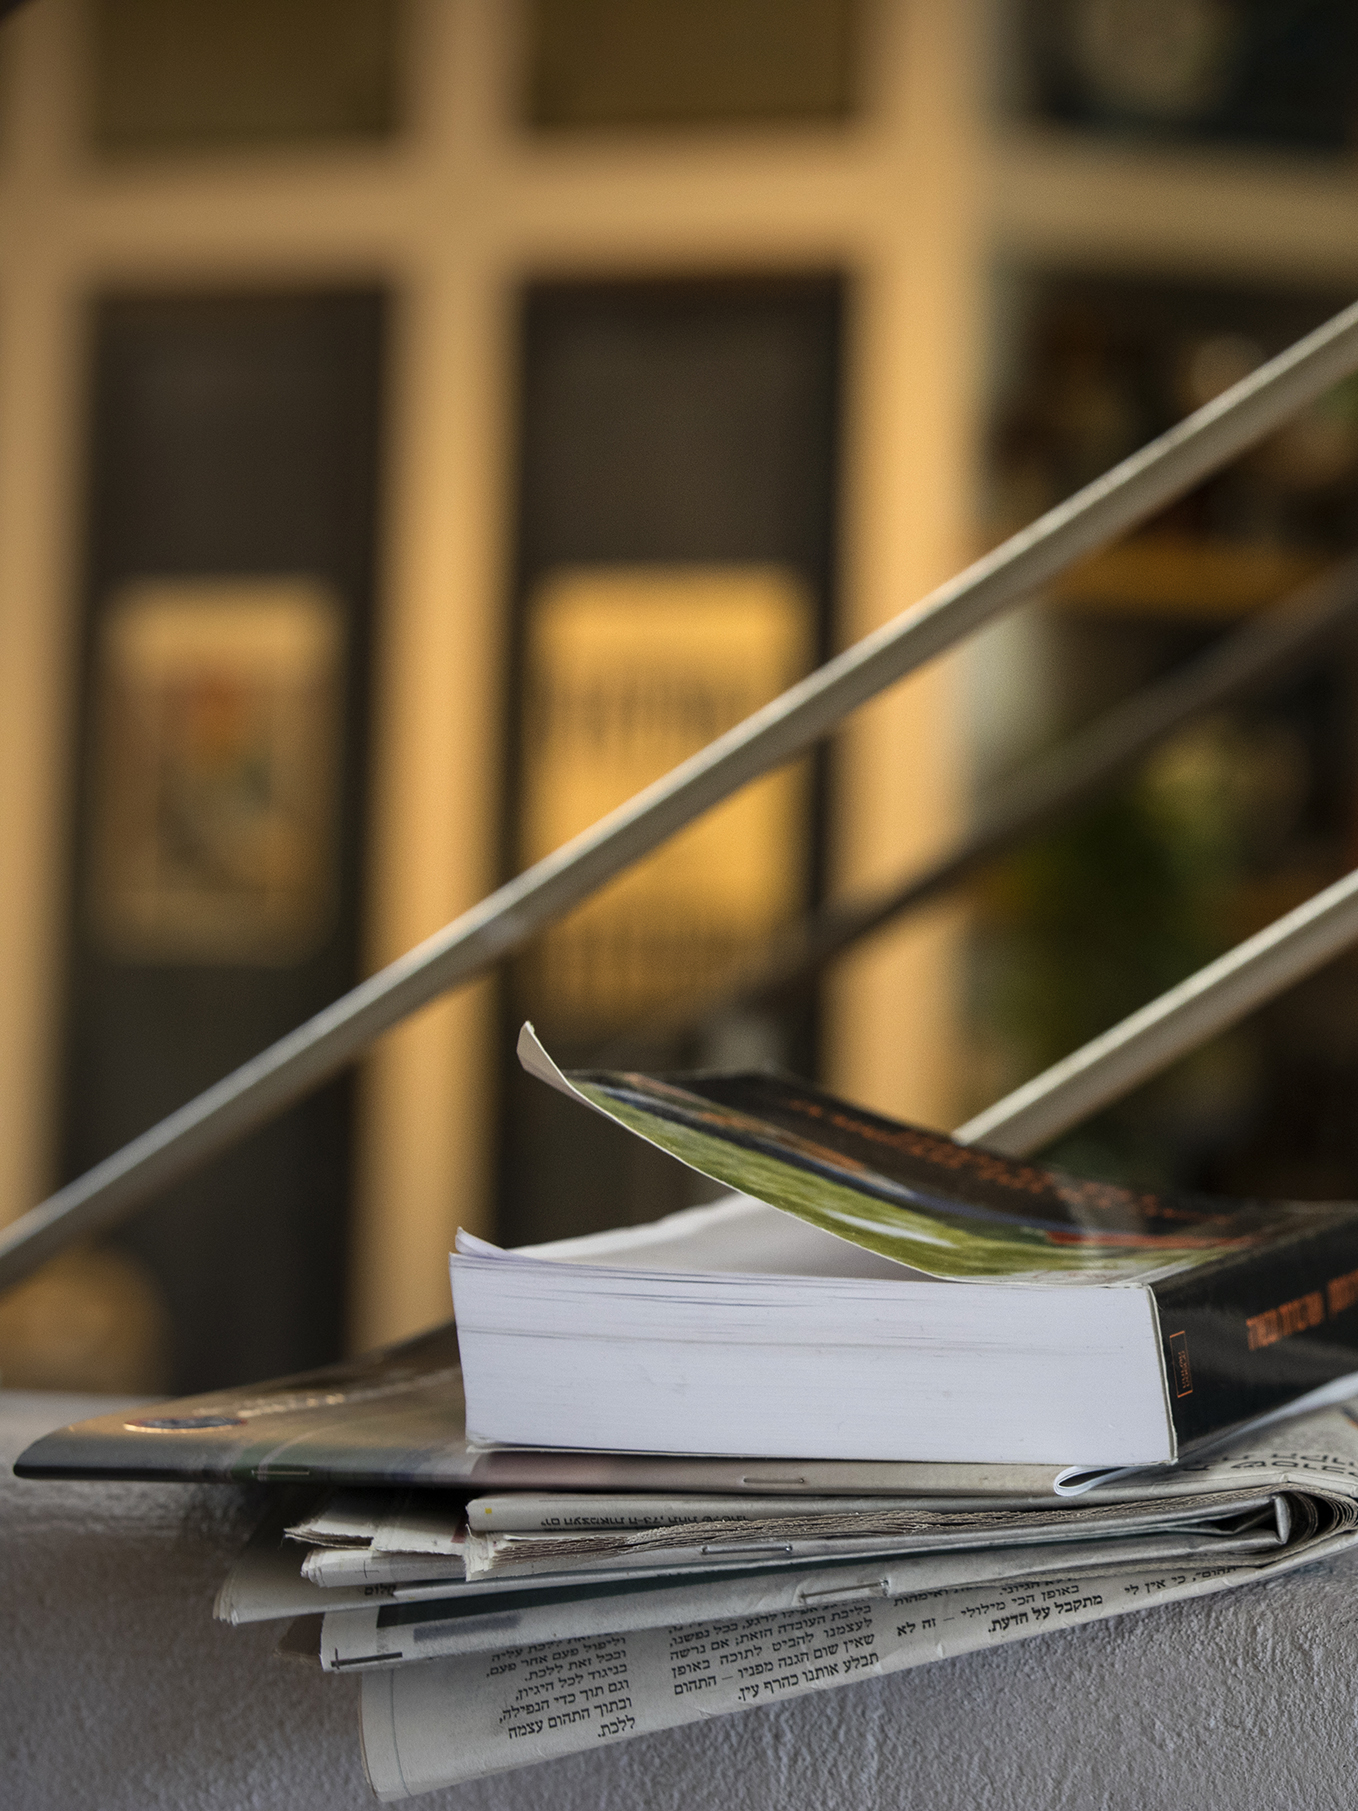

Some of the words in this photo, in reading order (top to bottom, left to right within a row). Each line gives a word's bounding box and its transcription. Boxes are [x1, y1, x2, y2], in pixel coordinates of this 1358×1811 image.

[541, 1517, 560, 1526] יום
[564, 1516, 625, 1526] העצמאות
[1144, 1579, 1166, 1594] אין
[1171, 1575, 1186, 1585] כי
[1041, 1584, 1080, 1602] באופן
[1124, 1584, 1140, 1596] לי
[1011, 1594, 1036, 1606] הכי
[1054, 1594, 1104, 1614] מתקבל
[960, 1601, 1006, 1618] מילולי
[1031, 1606, 1051, 1620] על
[778, 1615, 826, 1635] העובדה
[823, 1617, 873, 1639] לעצמנו
[897, 1621, 916, 1637] לא
[922, 1617, 937, 1630] זה
[988, 1611, 1029, 1633] הדעת.
[711, 1638, 730, 1651] אם
[772, 1632, 815, 1652] להביט
[844, 1633, 876, 1652] שאין
[521, 1655, 548, 1667] אחר
[552, 1647, 579, 1661] פעם
[596, 1650, 627, 1664] ובכל
[670, 1644, 706, 1661] נרשה
[719, 1645, 763, 1666] לתוכה
[778, 1652, 810, 1669] הגנה
[813, 1644, 839, 1660] שום
[568, 1657, 592, 1671] זאת
[671, 1659, 711, 1679] באופן
[738, 1661, 774, 1679] מפניו
[843, 1650, 880, 1673] תבלע
[524, 1663, 564, 1681] ללכת.
[558, 1672, 584, 1688] לכל
[588, 1662, 628, 1680] בניגוד
[802, 1664, 840, 1682] אותנו
[515, 1682, 554, 1701] היגיון,
[580, 1685, 604, 1700] תוך
[608, 1679, 630, 1693] וגם
[674, 1675, 717, 1695] התהום
[737, 1683, 760, 1701] עין.
[763, 1674, 800, 1694] כהרף
[554, 1693, 576, 1705] כדי
[594, 1697, 632, 1717] ובתוך
[499, 1699, 550, 1723] הנפילה,
[548, 1707, 591, 1729] התהום
[508, 1719, 543, 1739] עצמה
[598, 1714, 635, 1738] ללכת.
